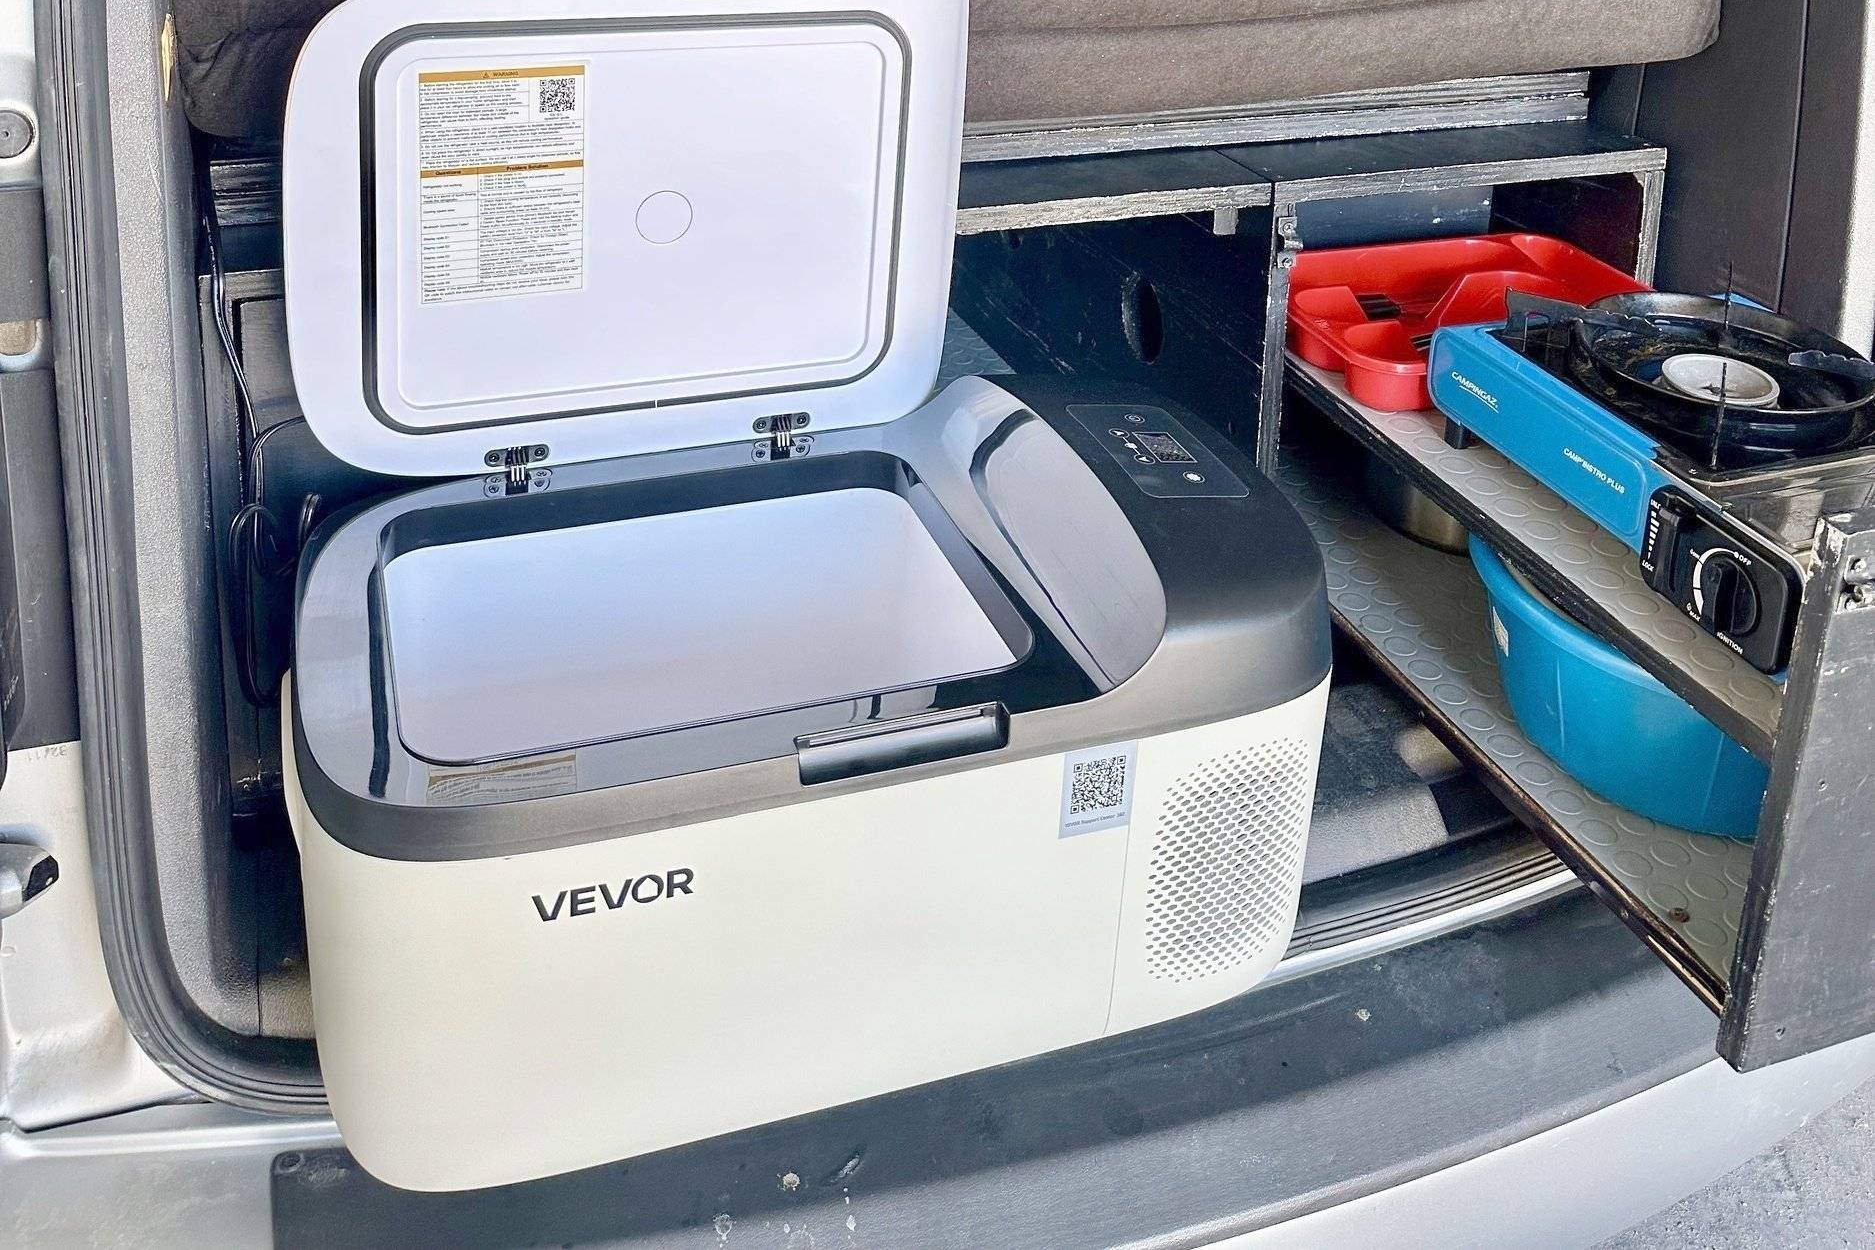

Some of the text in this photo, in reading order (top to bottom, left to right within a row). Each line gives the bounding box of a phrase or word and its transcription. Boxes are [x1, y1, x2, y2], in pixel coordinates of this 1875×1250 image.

[1451, 371, 1498, 406] CAMPINGAZ
[1606, 477, 1625, 494] PLUS
[1642, 559, 1655, 572] LOCK
[1739, 554, 1752, 566] OFF
[1689, 610, 1701, 622] MAX
[1716, 631, 1743, 655] IGNITION
[531, 867, 694, 922] VEVOR
